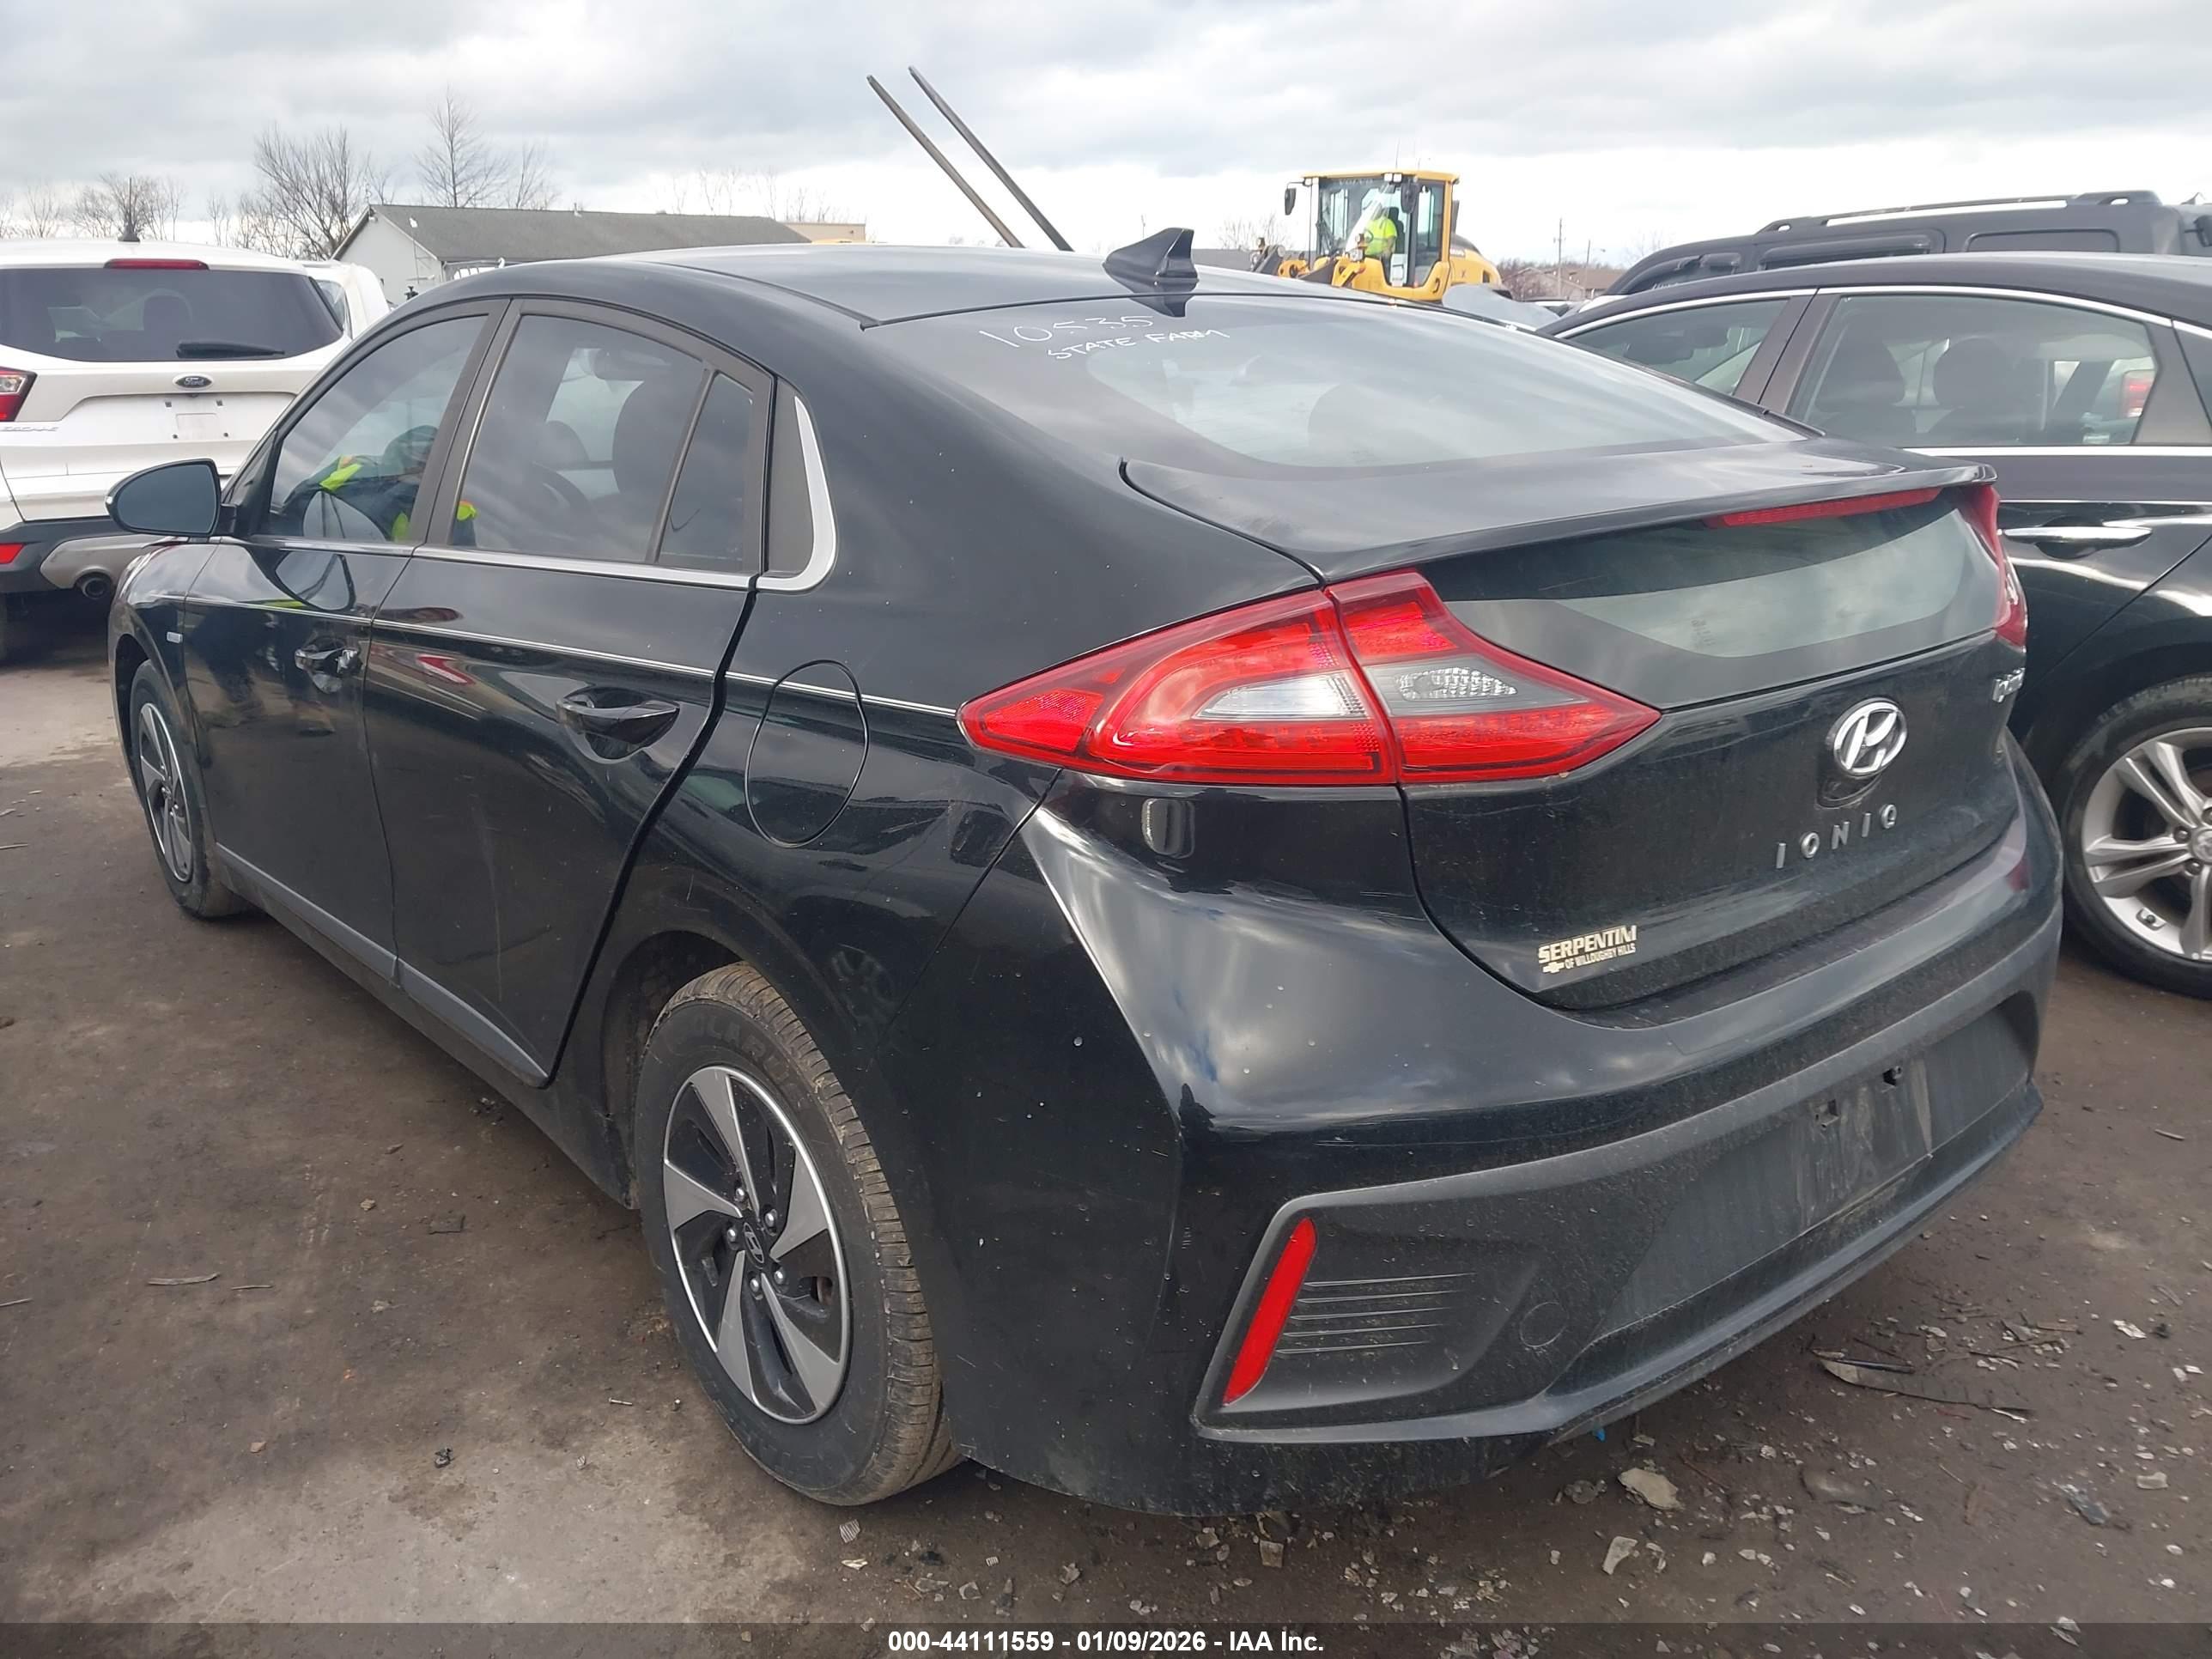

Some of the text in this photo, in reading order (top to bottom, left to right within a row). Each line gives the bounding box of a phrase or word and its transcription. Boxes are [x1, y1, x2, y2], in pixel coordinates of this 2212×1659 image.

[1048, 337, 1136, 359] STATE
[1776, 804, 1897, 869] IONIQ
[1538, 925, 1637, 964] SERPENTINI
